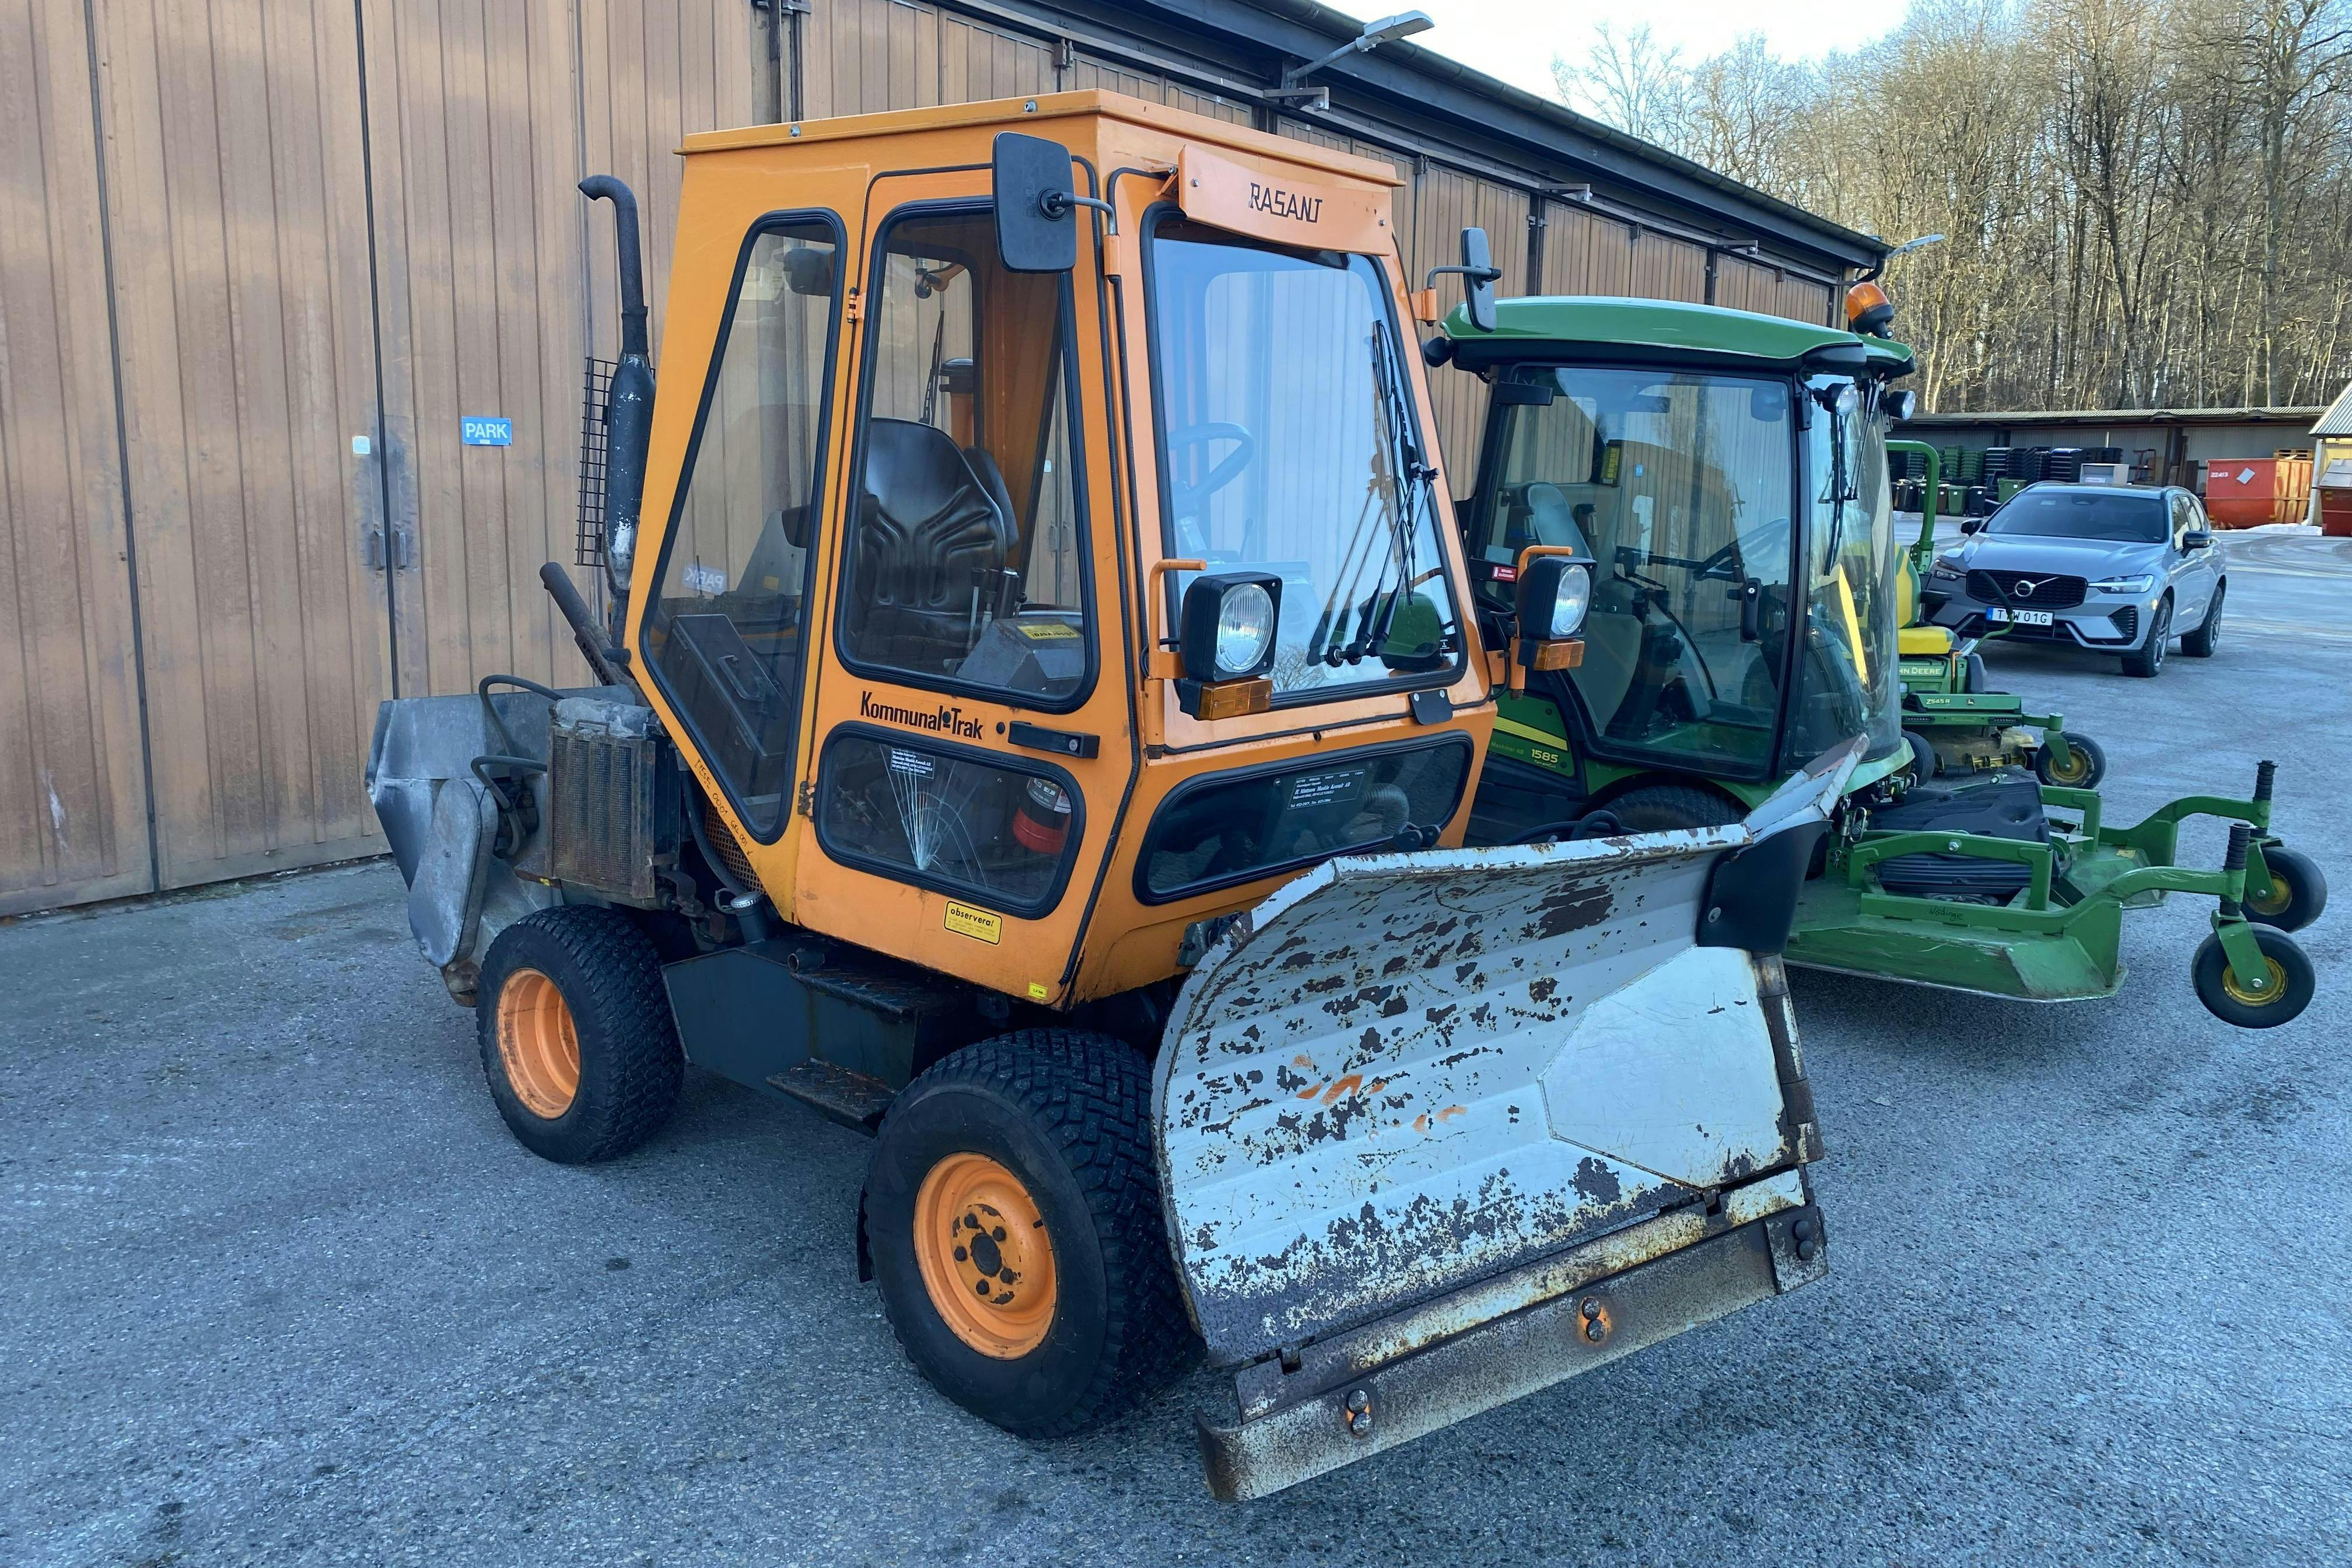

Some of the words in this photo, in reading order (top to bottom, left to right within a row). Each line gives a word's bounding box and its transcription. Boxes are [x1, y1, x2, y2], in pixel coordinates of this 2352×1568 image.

[1250, 183, 1322, 223] RASANT
[466, 423, 508, 439] PARK
[1997, 610, 2020, 622] TW
[1531, 748, 1559, 763] 1585
